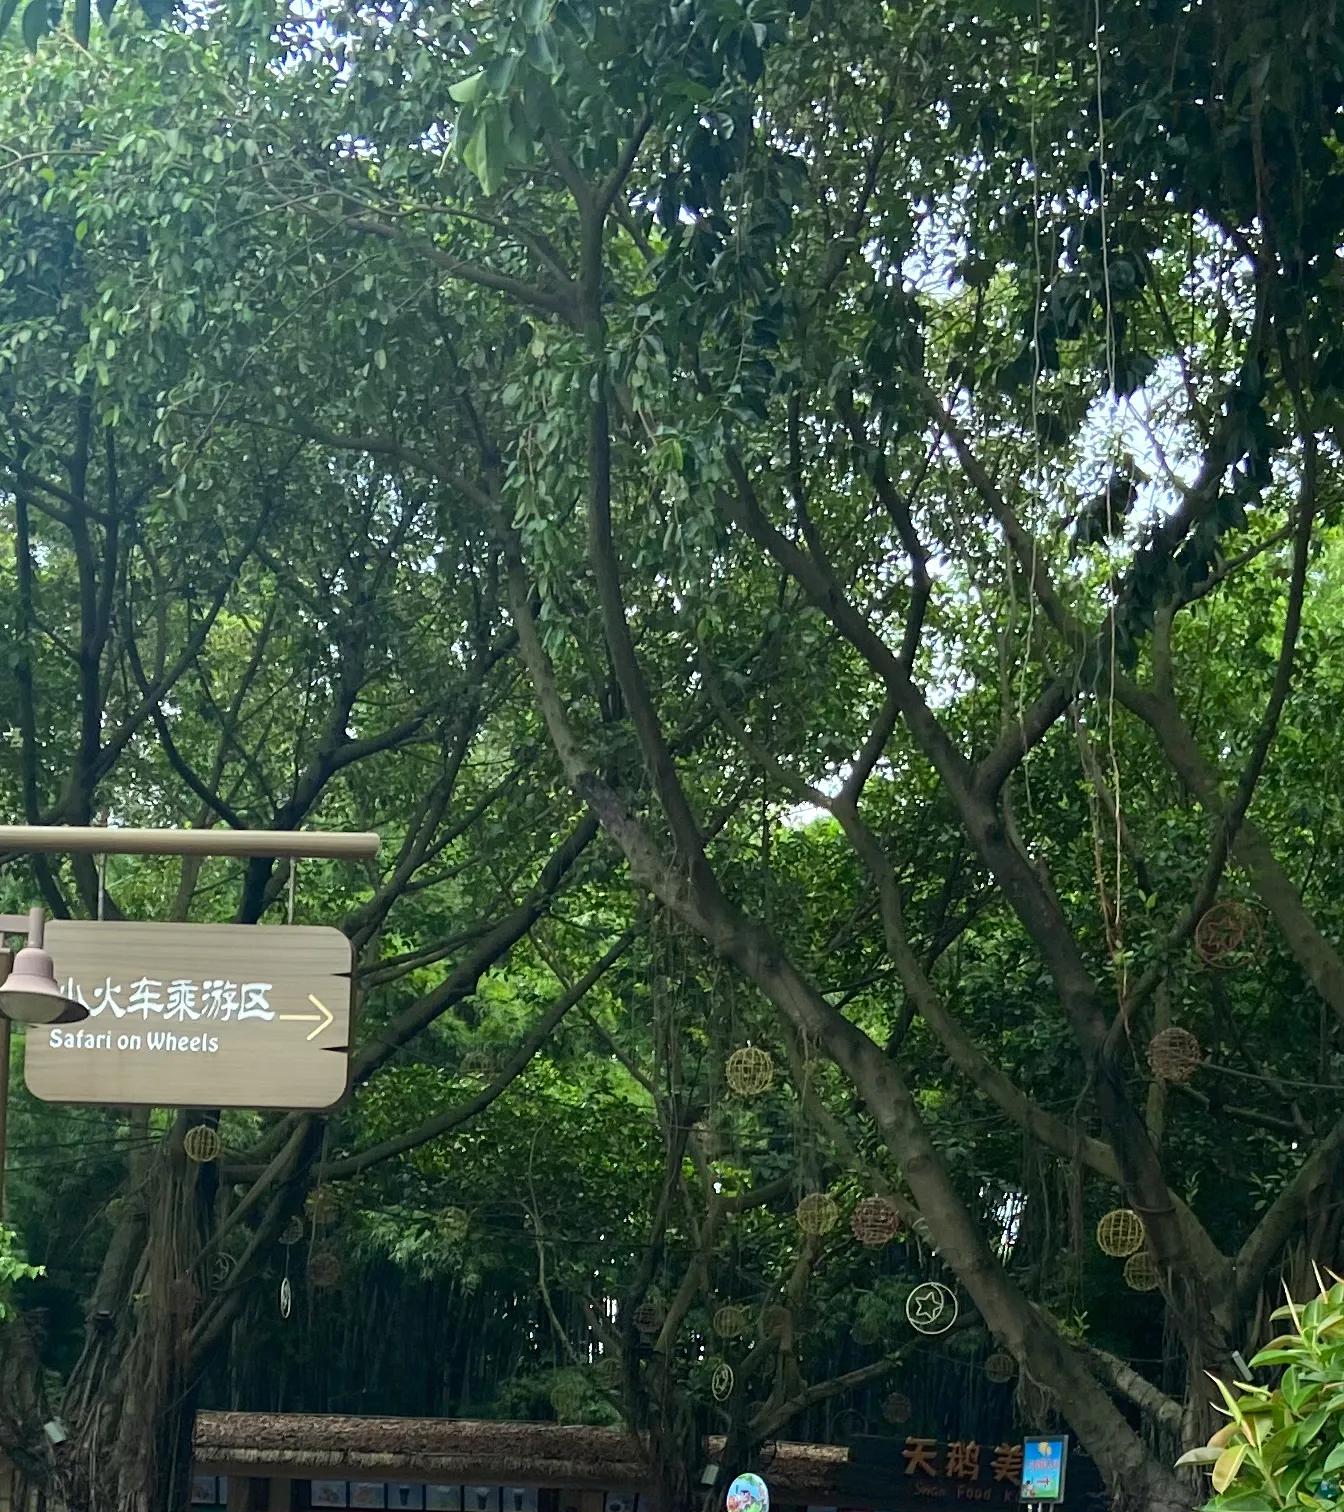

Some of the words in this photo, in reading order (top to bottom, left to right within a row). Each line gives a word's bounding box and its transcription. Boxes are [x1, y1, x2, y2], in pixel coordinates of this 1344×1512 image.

[60, 976, 275, 1022] 小火车乘游区
[49, 1028, 112, 1050] Safari
[117, 1035, 141, 1051] on
[146, 1031, 219, 1053] Wheels
